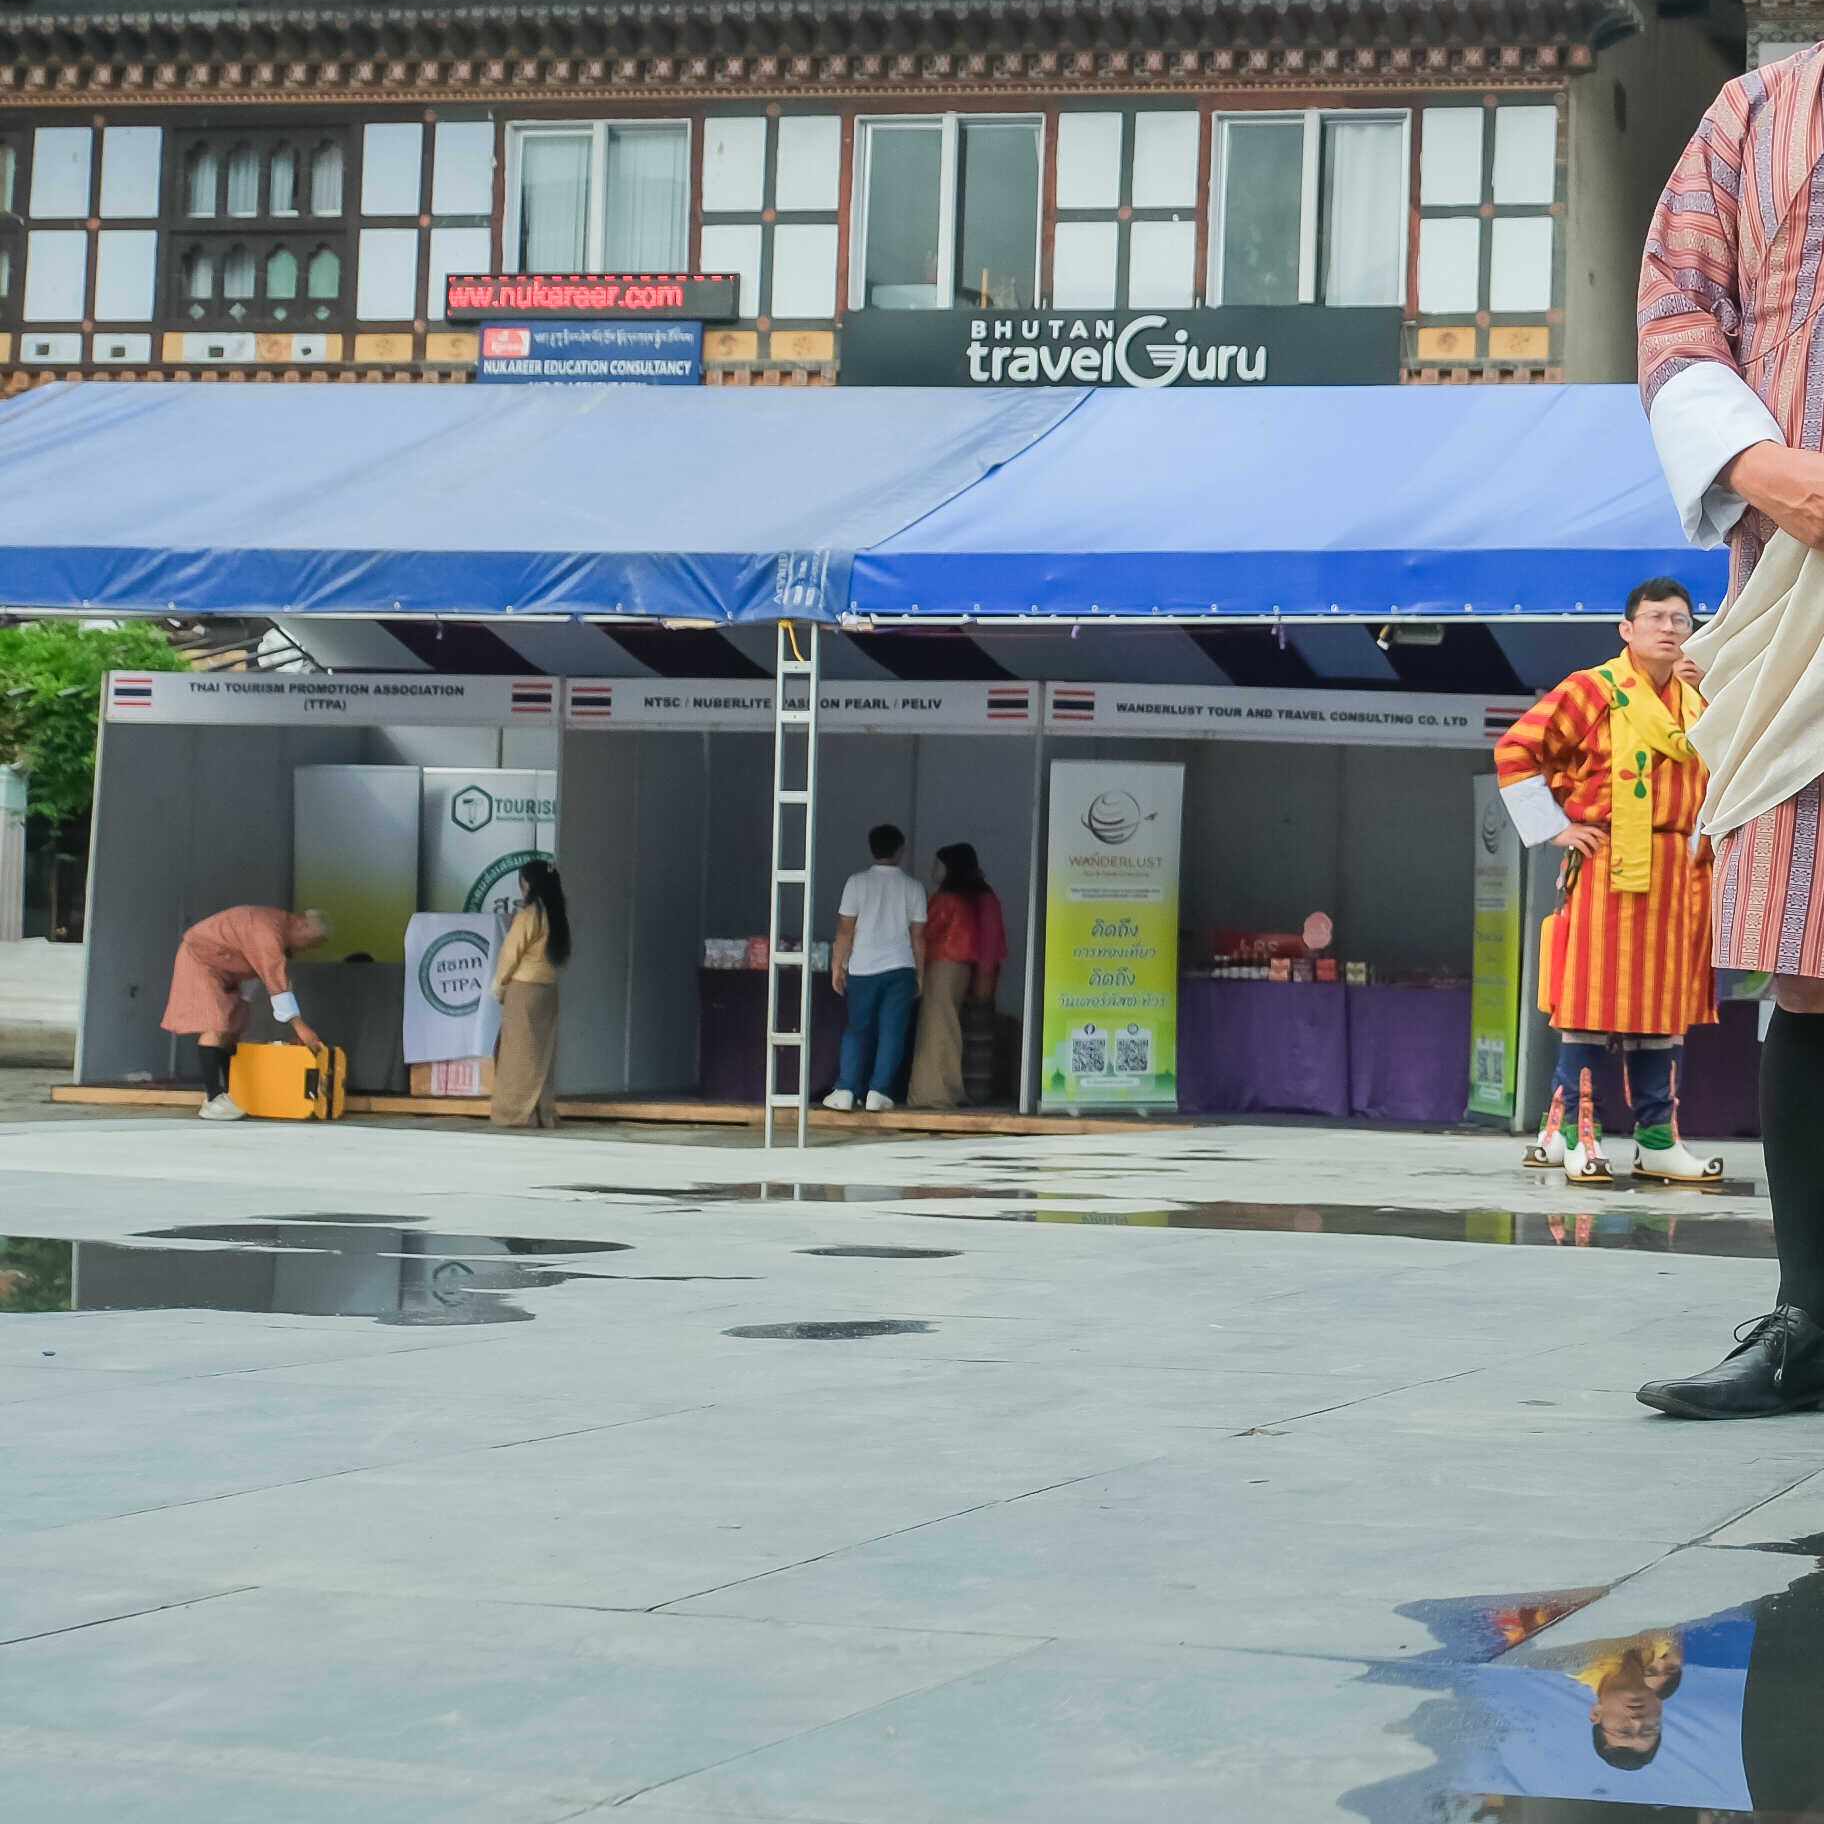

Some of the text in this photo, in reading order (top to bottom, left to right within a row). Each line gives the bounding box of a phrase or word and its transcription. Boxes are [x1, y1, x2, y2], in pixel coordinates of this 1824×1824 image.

[970, 319, 1115, 340] BHUTAN
[483, 359, 692, 376] NUKAREER EDUCATION CONSULTANCY
[225, 683, 285, 694] TOURISM
[288, 684, 369, 695] PROMOTION
[374, 685, 465, 696] ASSOCIATION
[304, 699, 347, 711] (TTPA)
[644, 697, 680, 708] NTSC
[845, 699, 889, 709] PEARL
[902, 698, 942, 710] PELIV
[1116, 702, 1468, 727] WANDERLUST TOUR AND TRAVEL CONSULTING CO. LTD
[495, 798, 556, 815] TOURIS
[1069, 854, 1163, 868] WANDERLUST
